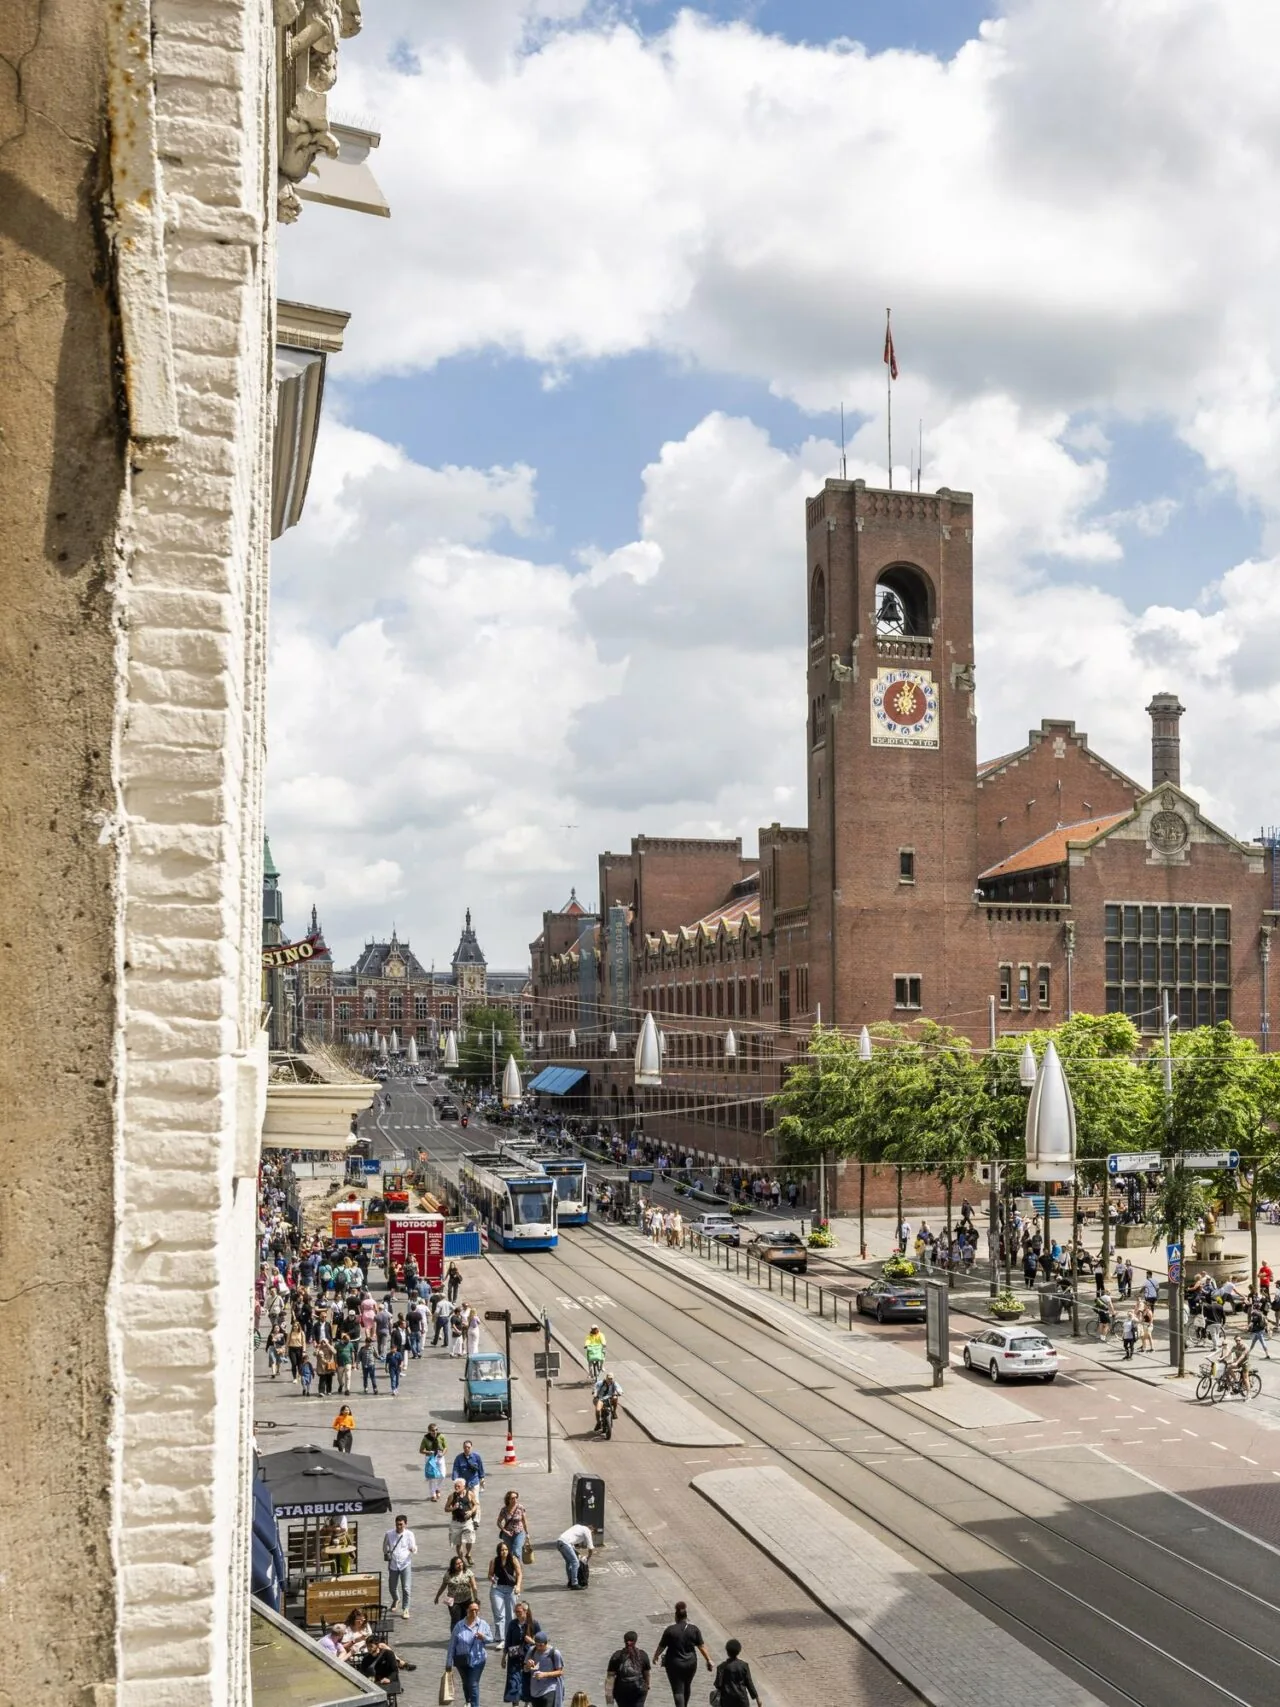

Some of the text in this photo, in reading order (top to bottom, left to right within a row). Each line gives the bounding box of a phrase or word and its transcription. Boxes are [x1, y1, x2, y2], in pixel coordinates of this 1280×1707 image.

[615, 922, 624, 954] BEURS
[275, 1501, 363, 1517] STARBUCKS
[318, 1588, 368, 1598] STARBUCKS
